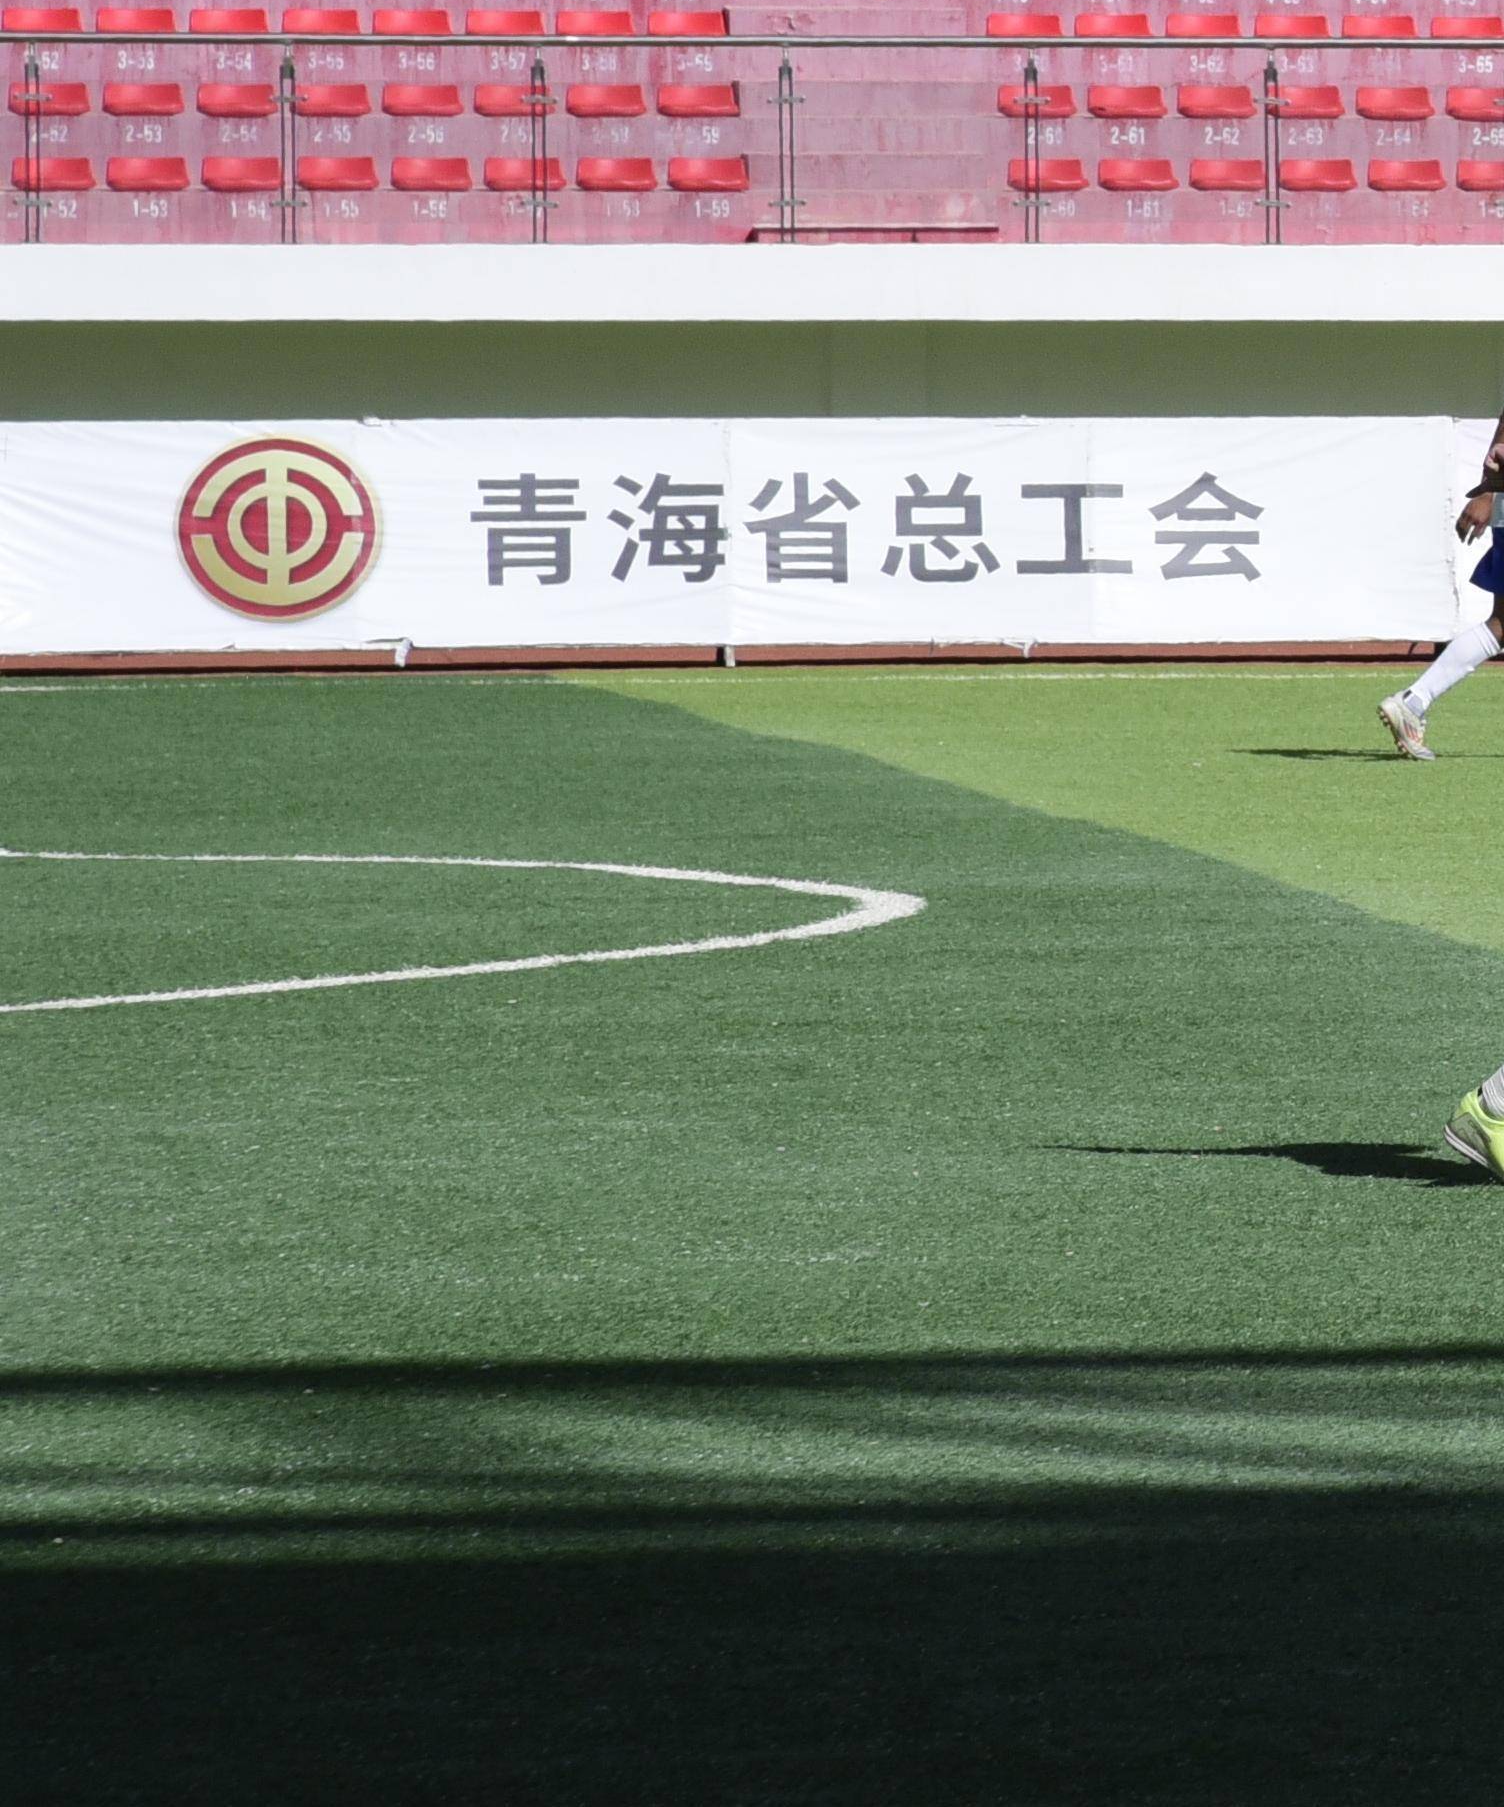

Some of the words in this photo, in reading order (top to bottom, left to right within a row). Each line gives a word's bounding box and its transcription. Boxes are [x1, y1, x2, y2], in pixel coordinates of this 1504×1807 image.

[216, 52, 253, 72] 3-54
[398, 51, 435, 71] 3-56
[1458, 55, 1494, 74] 3-65
[408, 124, 445, 144] 2-56
[1110, 125, 1145, 146] 2-61
[695, 198, 731, 218] 1-59
[470, 472, 1264, 587] 青海省总工会
